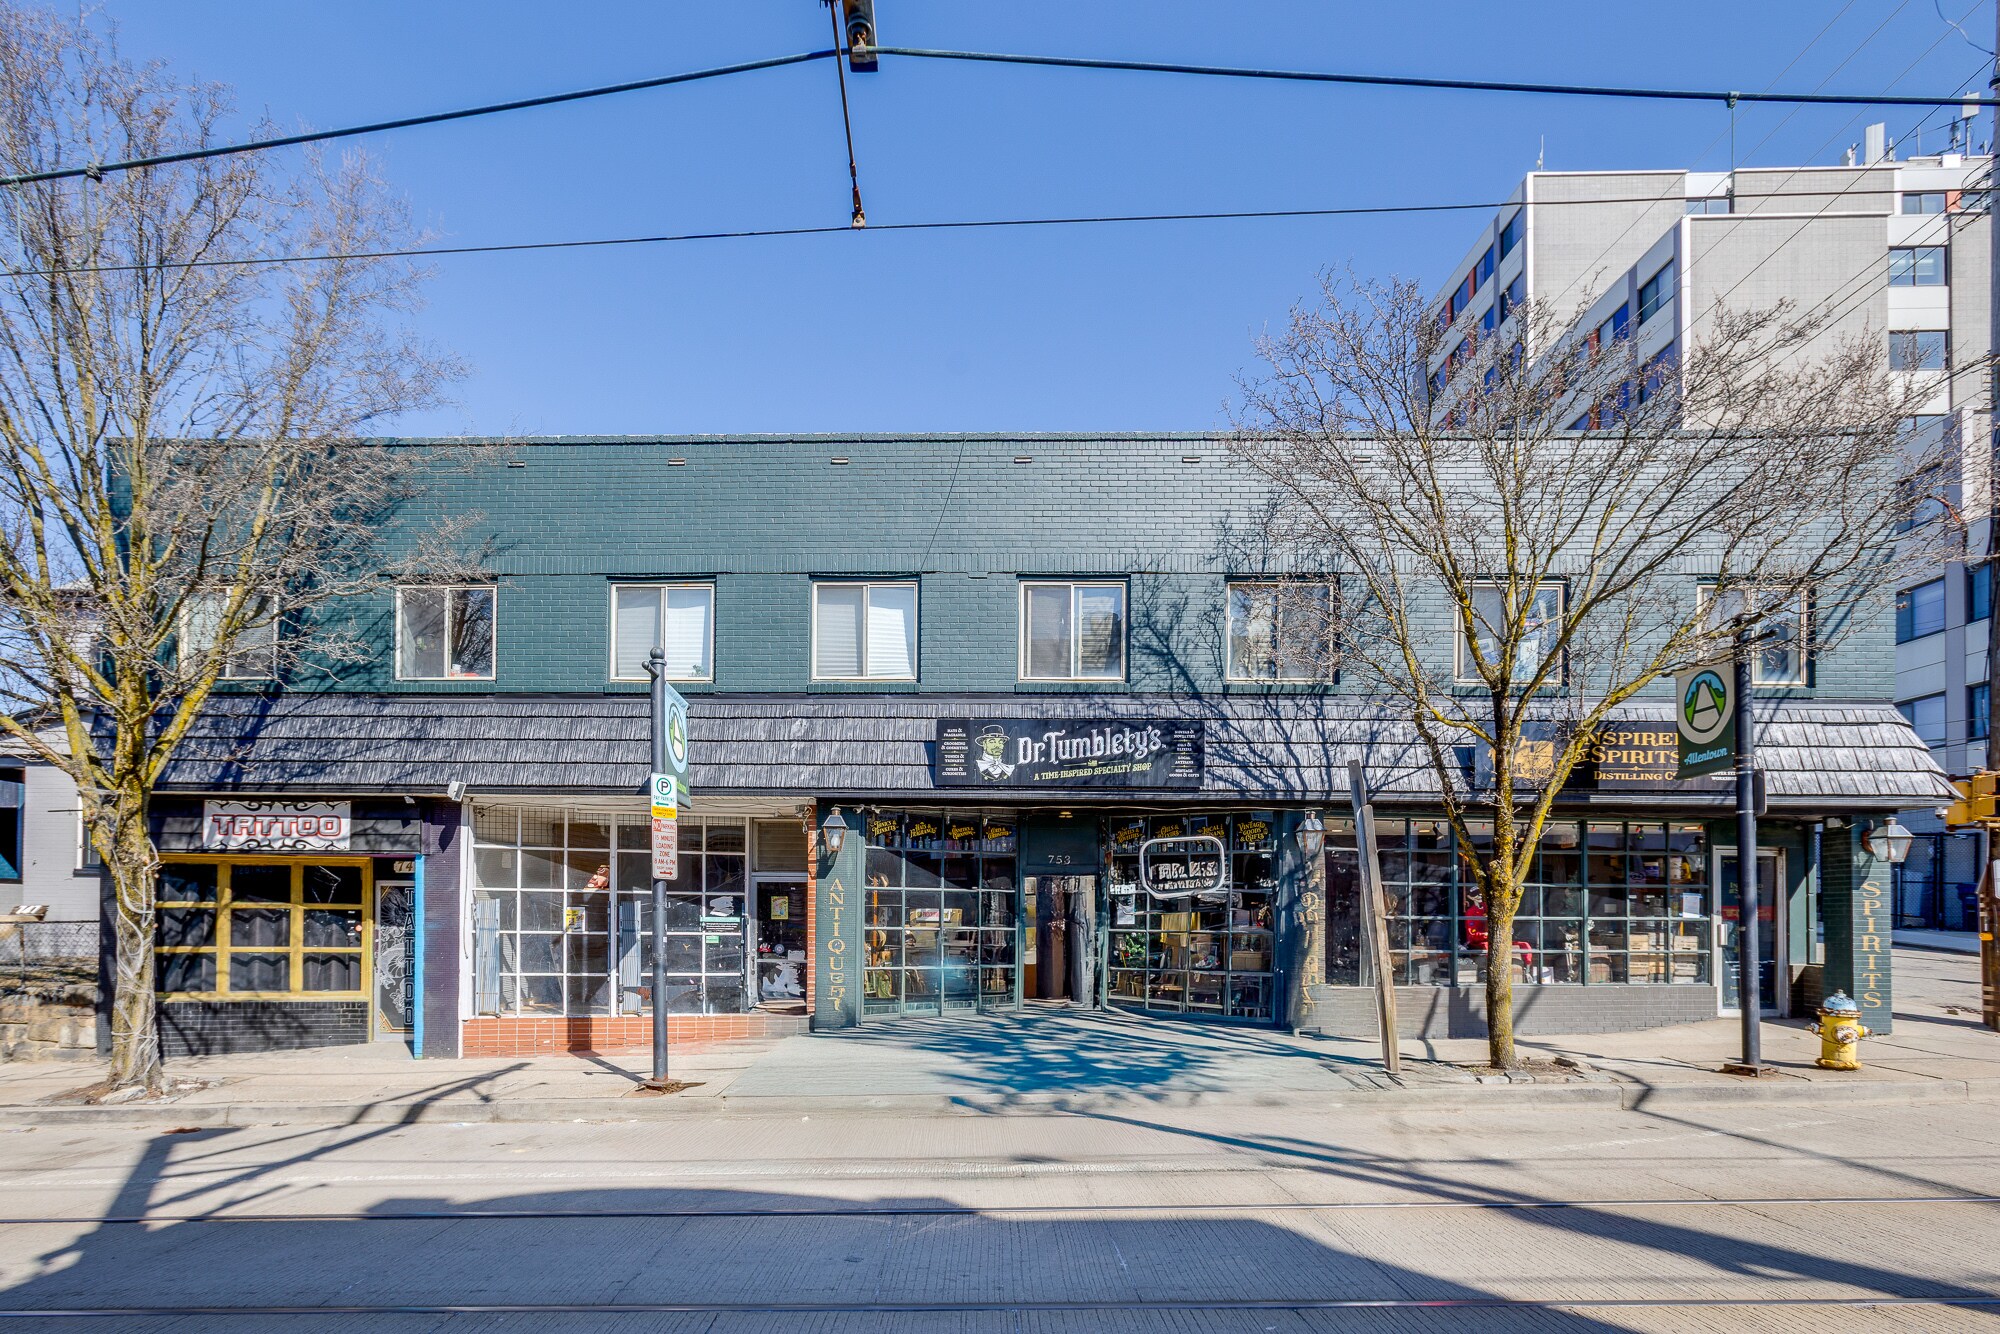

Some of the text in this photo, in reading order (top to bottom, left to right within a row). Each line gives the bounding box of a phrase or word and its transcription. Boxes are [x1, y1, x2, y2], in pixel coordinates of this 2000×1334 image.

[1017, 737, 1045, 764] Dr.
[1043, 725, 1161, 764] Tumblety's
[1585, 732, 1679, 747] NSPIRE
[1684, 747, 1728, 765] Allentown
[1094, 763, 1132, 776] SPECIALTY
[1594, 771, 1662, 780] DISTILLING
[212, 814, 341, 836] TATTOO
[1245, 834, 1264, 842] GIFTS
[396, 861, 413, 872] 74
[1048, 855, 1070, 864] 753
[1862, 881, 1882, 1008] SPIRITS
[404, 888, 415, 1025] TATTOO
